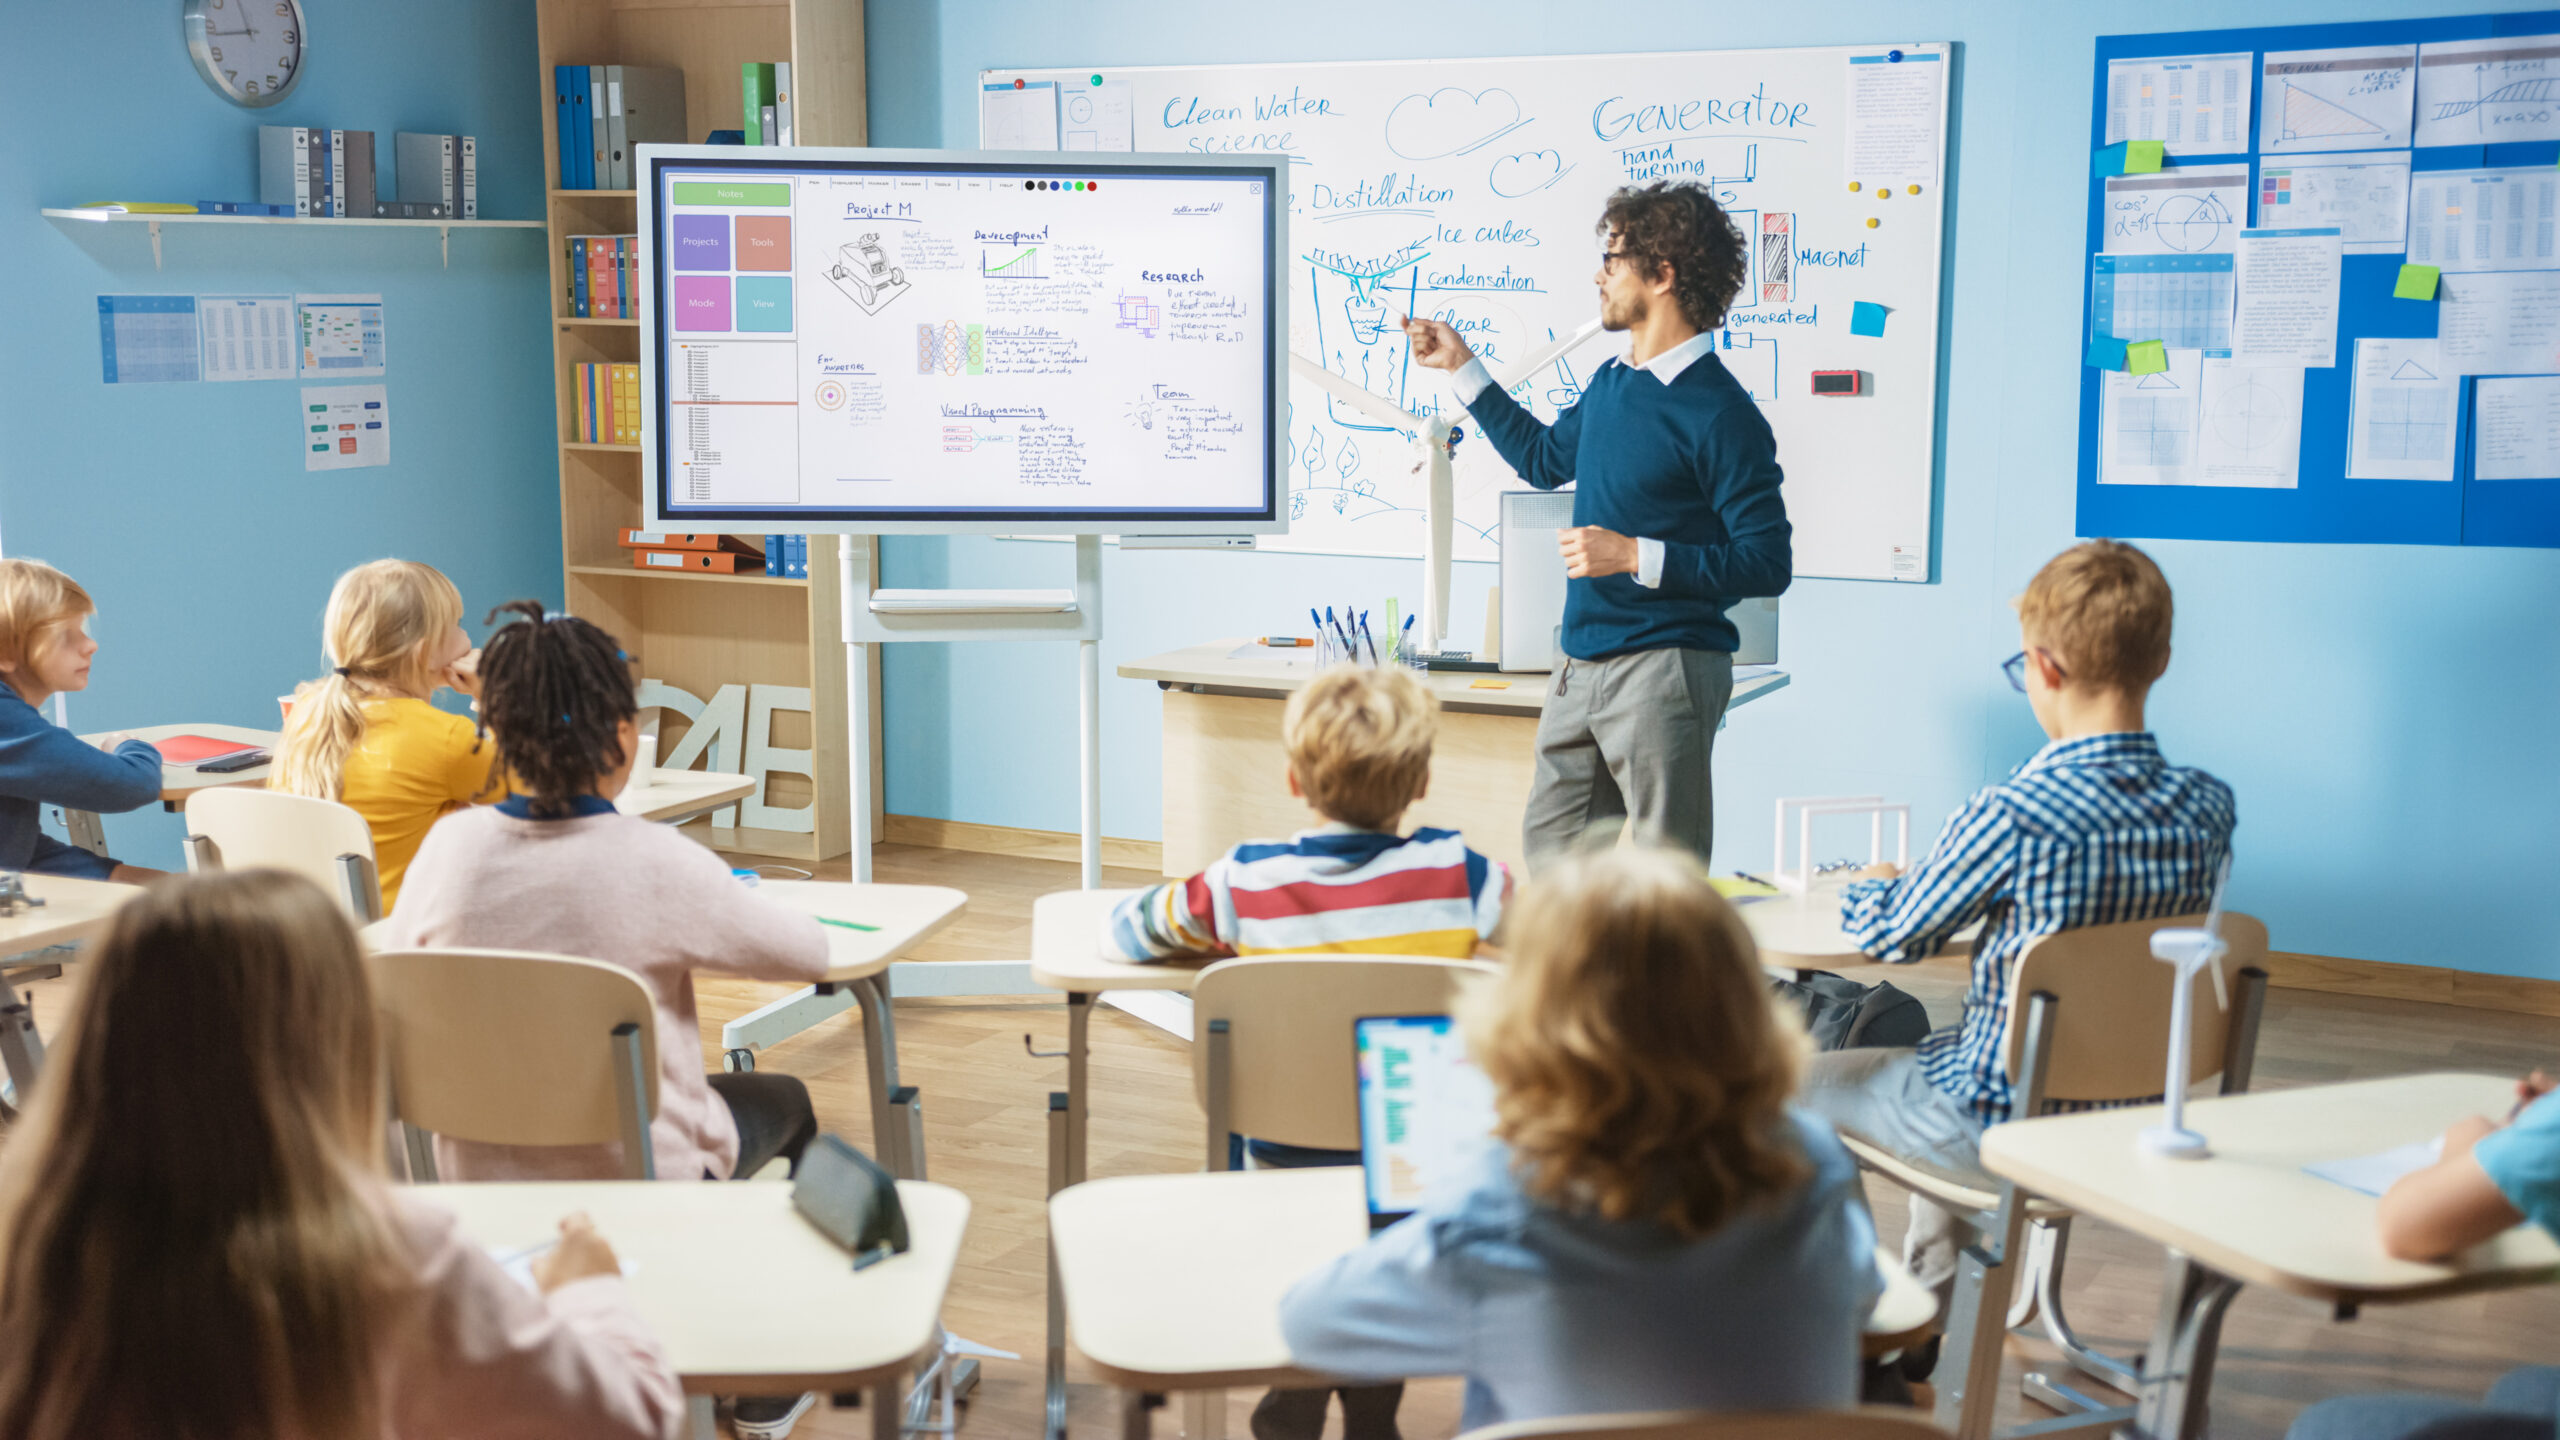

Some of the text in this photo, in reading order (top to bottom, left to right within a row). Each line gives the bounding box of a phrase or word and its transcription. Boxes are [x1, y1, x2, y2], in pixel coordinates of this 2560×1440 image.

[275, 3, 289, 17] 2
[283, 30, 295, 44] 3
[211, 46, 223, 62] 8
[278, 56, 291, 71] 4
[225, 69, 238, 84] 7
[266, 75, 279, 89] 5
[246, 80, 259, 95] 6
[1163, 86, 1345, 128] Clean Water
[1592, 82, 1817, 142] Generator
[1185, 132, 1299, 154] science
[1622, 143, 1675, 166] hand
[1625, 158, 1705, 181] turning
[717, 189, 744, 198] Notes
[1311, 173, 1454, 209] Distillation
[899, 202, 912, 216] M
[974, 224, 1048, 246] Development
[1437, 219, 1540, 247] Ice cubes
[682, 237, 719, 248] Projects
[750, 238, 774, 247] Tools
[1800, 242, 1872, 267] Magnet
[1141, 267, 1204, 283] Research
[1427, 264, 1535, 292] condensation
[688, 299, 715, 307] Mode
[752, 299, 775, 308] View
[1432, 308, 1501, 334] Clear
[1731, 304, 1818, 327] generated
[1464, 335, 1505, 364] ter
[1152, 383, 1190, 400] Team
[941, 402, 967, 417] Visual
